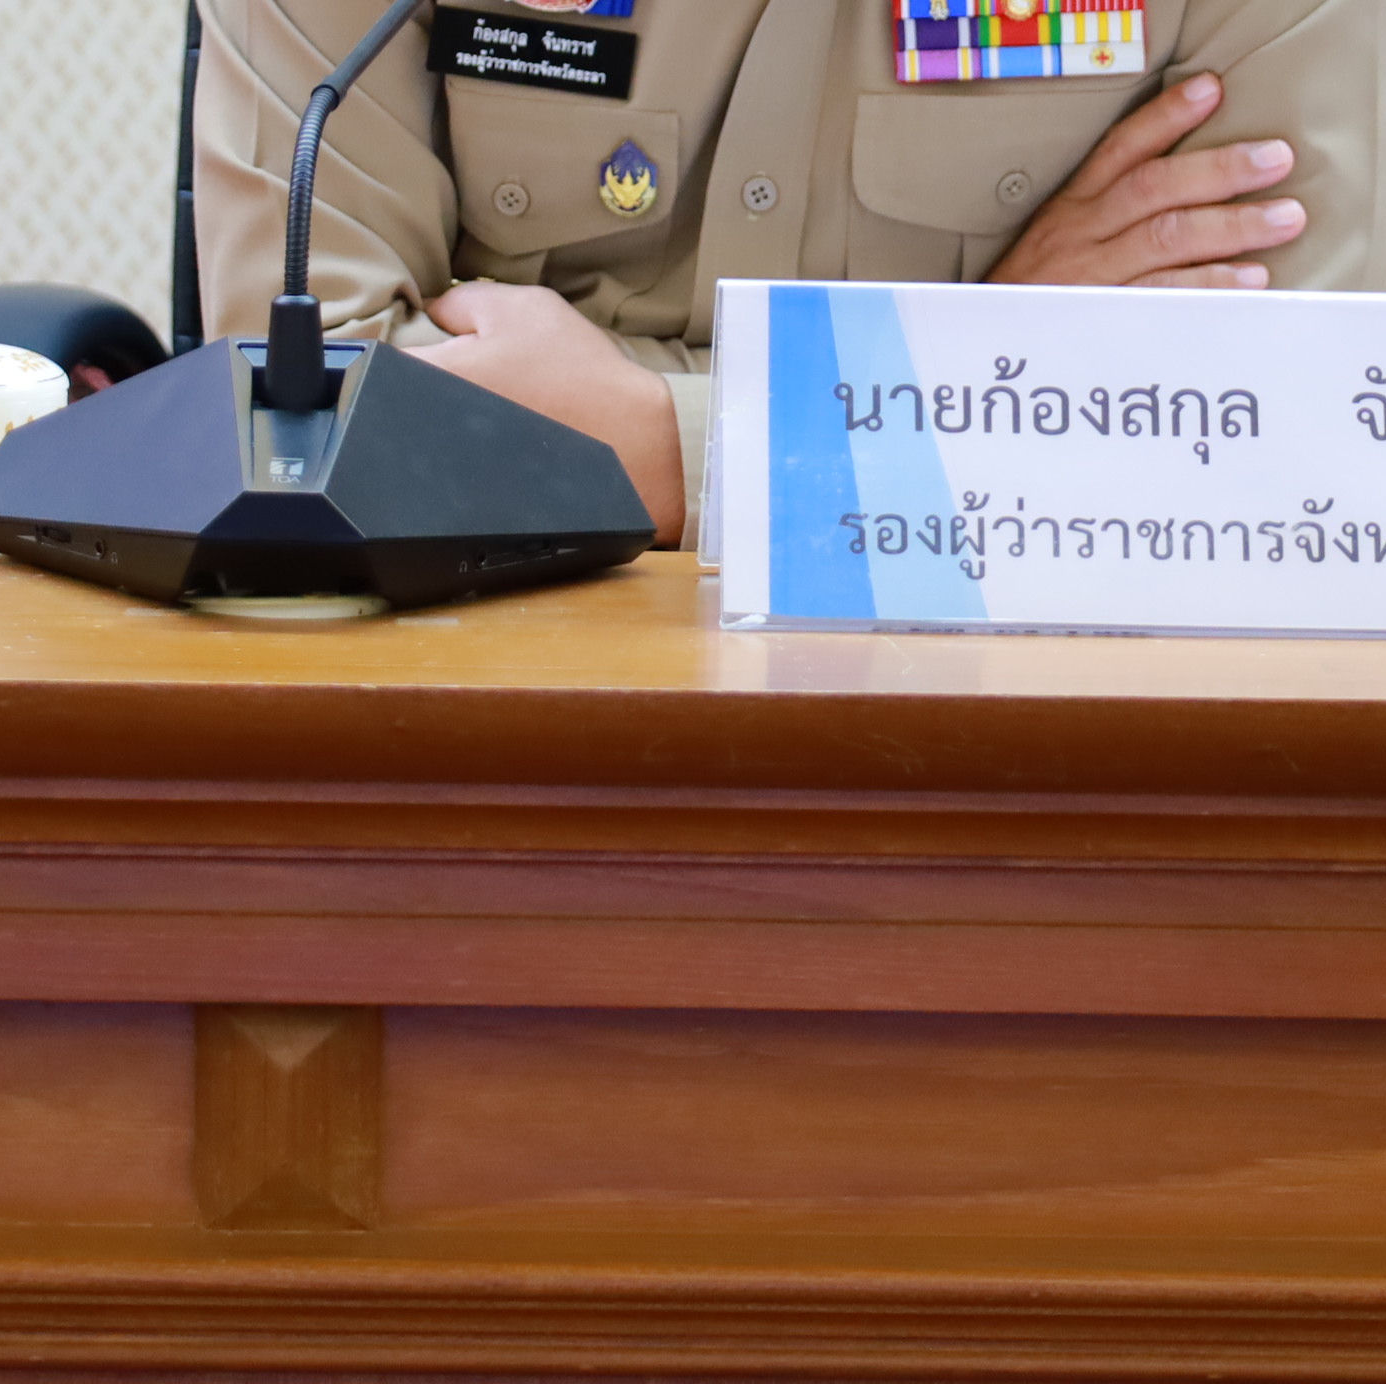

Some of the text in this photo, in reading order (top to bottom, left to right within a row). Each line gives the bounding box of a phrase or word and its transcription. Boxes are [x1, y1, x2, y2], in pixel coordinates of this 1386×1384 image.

[473, 18, 597, 56] ก้องสกุล จันทราช
[456, 49, 606, 85] รองผู้ว่าราชการจังหวัดยะลา
[833, 354, 1260, 465] นายก้องสกุล
[270, 476, 301, 484] TOA
